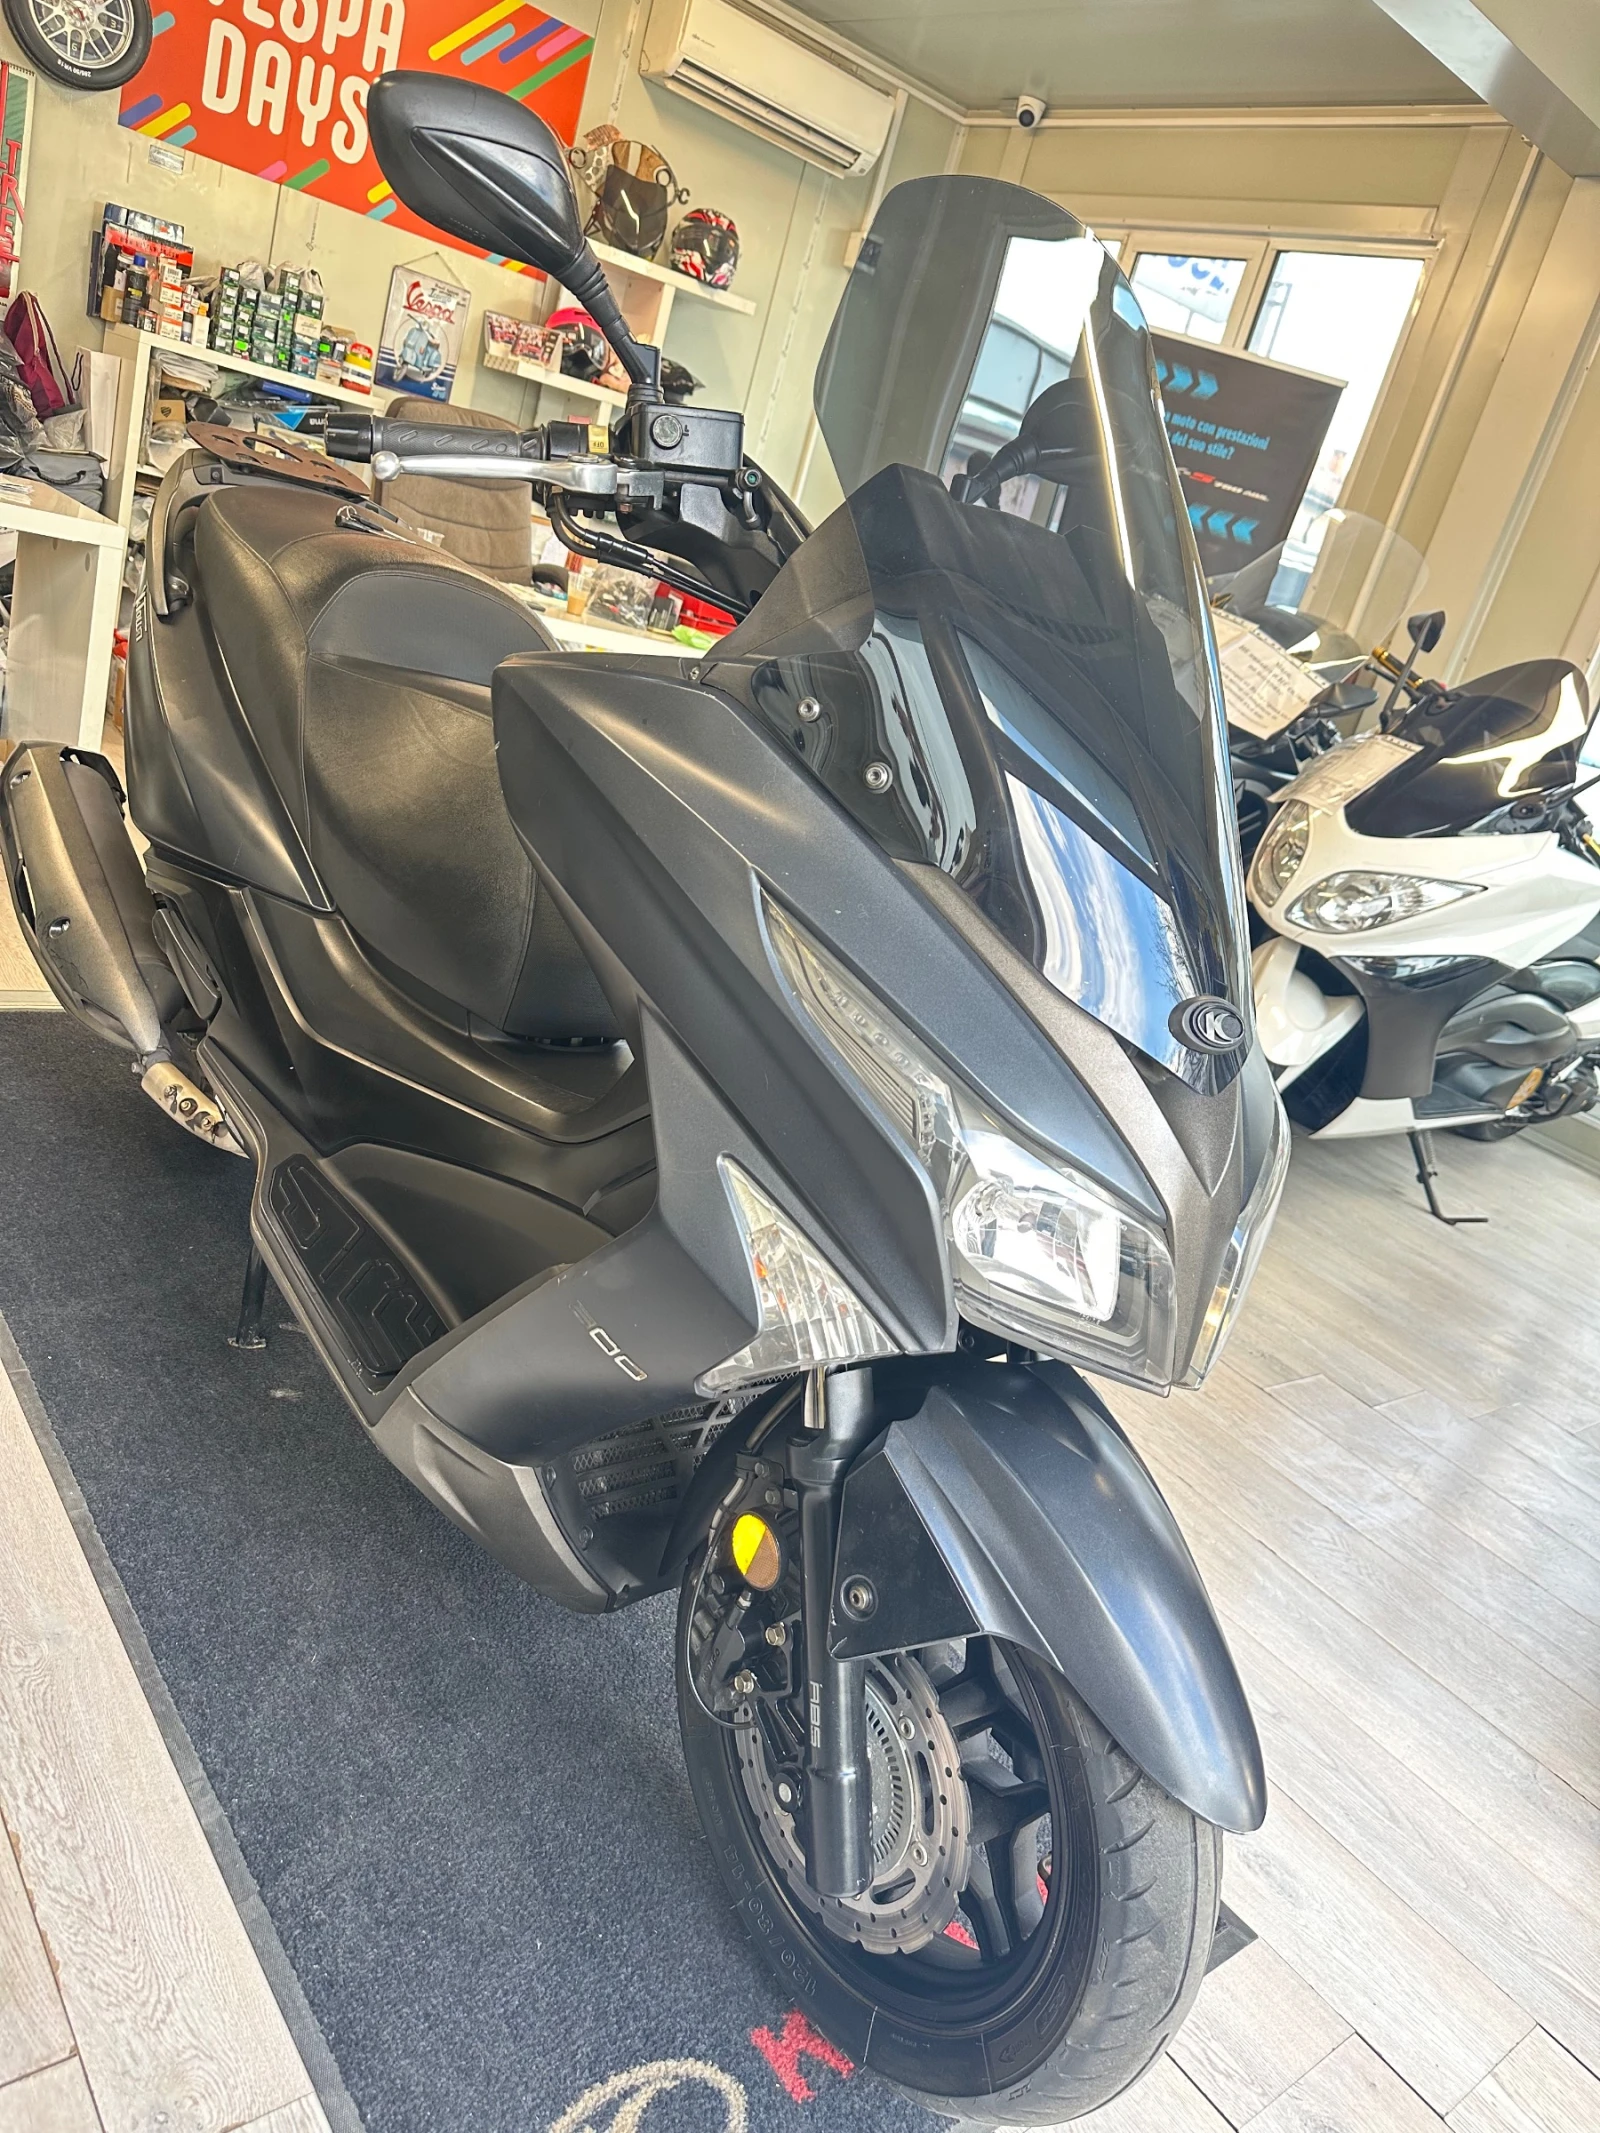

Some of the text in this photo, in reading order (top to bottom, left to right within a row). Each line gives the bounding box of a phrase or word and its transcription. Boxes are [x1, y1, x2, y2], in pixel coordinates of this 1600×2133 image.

[202, 18, 372, 164] DAYS
[403, 280, 455, 325] Vespa
[1171, 413, 1197, 430] moto
[1197, 421, 1216, 436] con
[1215, 426, 1271, 451] prestazioni
[809, 1680, 821, 1749] ABS
